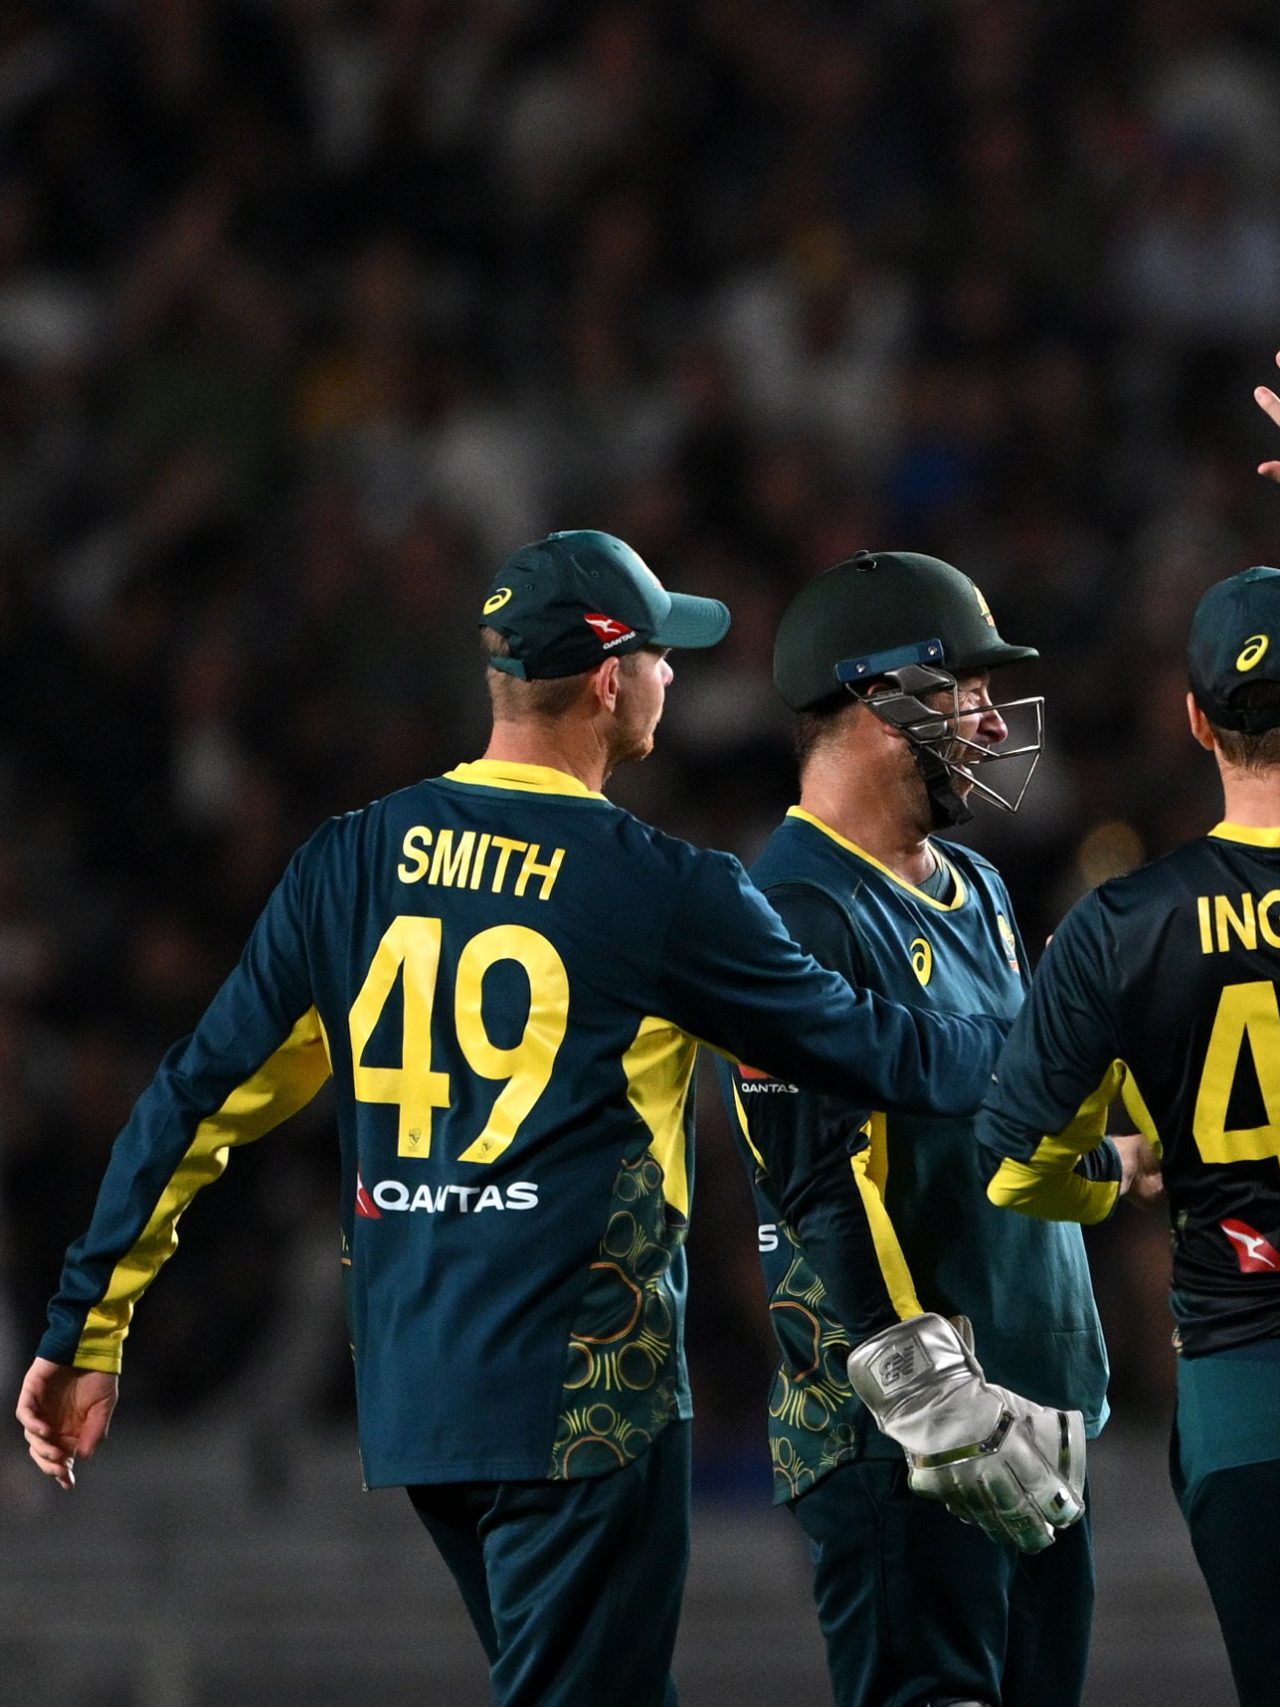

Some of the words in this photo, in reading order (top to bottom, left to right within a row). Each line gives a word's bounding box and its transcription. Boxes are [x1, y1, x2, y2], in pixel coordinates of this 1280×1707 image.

[603, 630, 636, 650] QANTAS
[397, 825, 566, 900] SMITH
[349, 916, 569, 1165] 49
[741, 1083, 799, 1093] QANTAS
[373, 1180, 539, 1213] QANTAS
